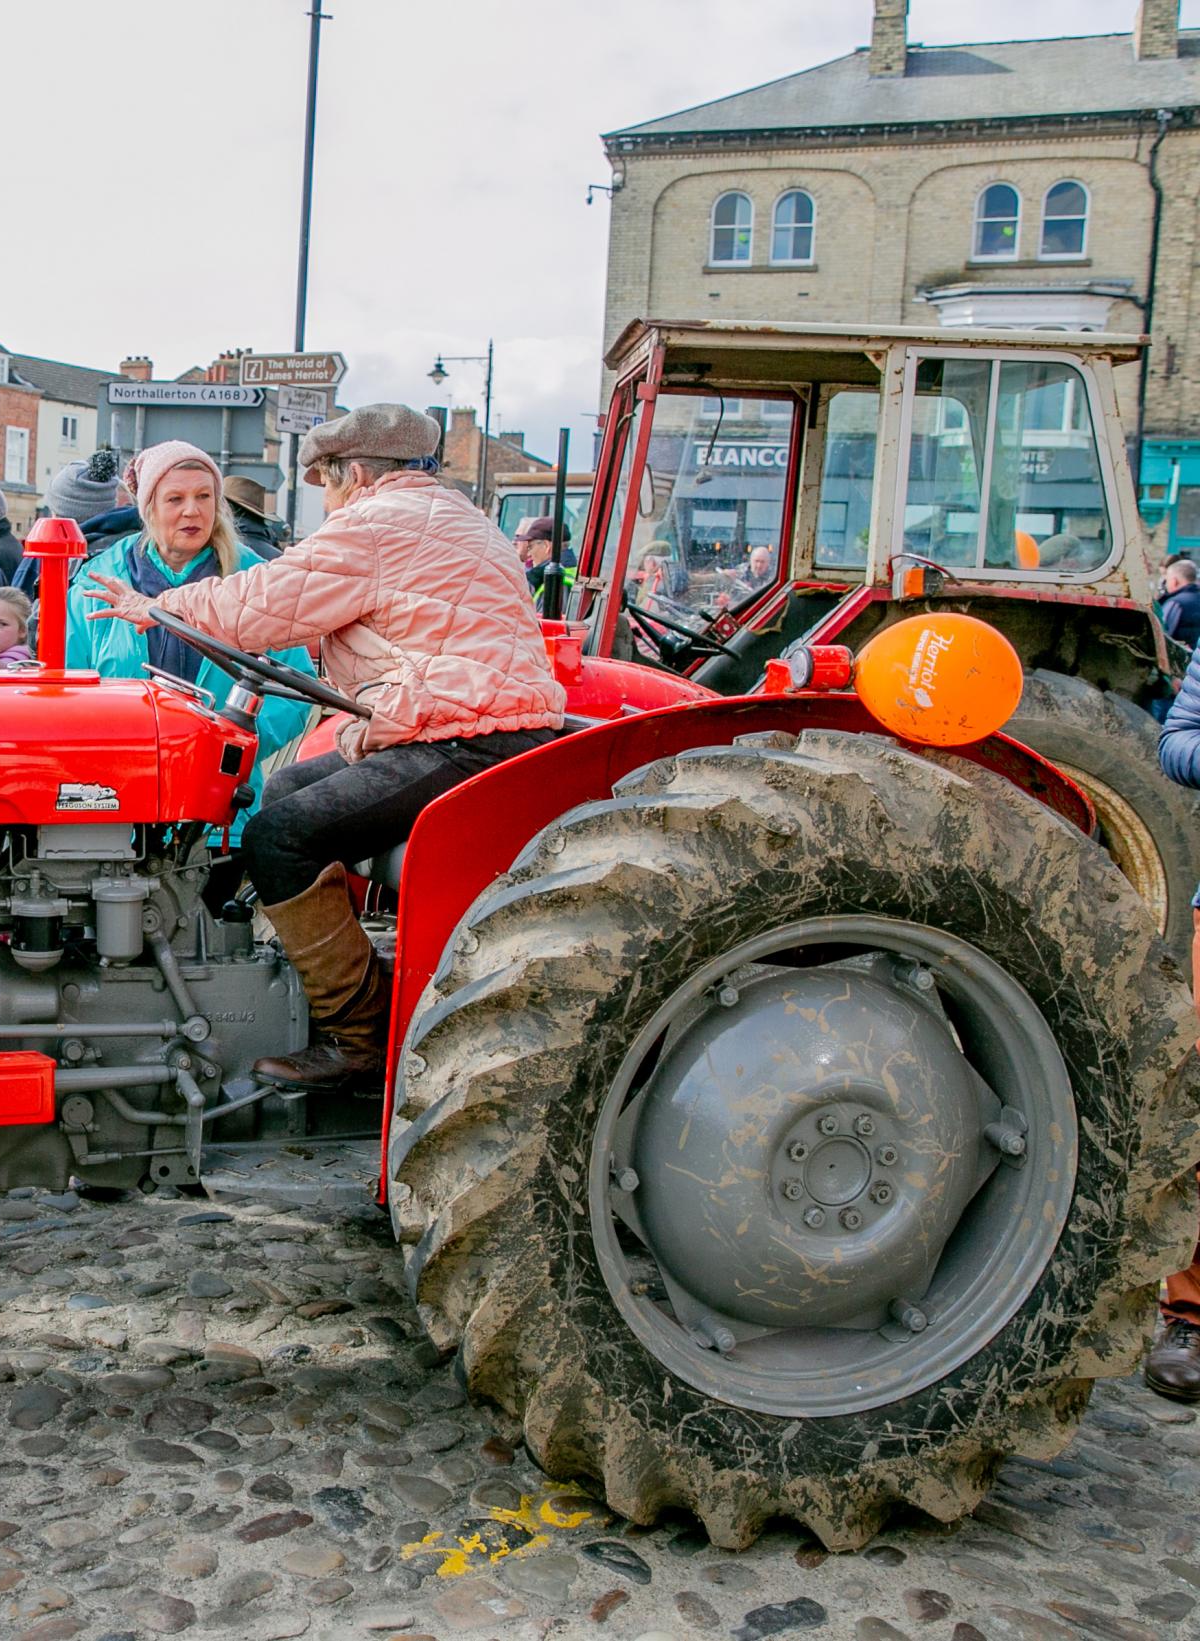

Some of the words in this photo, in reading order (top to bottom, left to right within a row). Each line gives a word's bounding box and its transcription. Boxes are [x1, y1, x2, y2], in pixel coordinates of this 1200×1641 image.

[268, 360, 284, 368] The
[286, 359, 314, 369] World
[316, 359, 327, 368] of
[264, 371, 292, 380] James
[295, 370, 328, 380] Herriot
[114, 387, 197, 400] Northallerton
